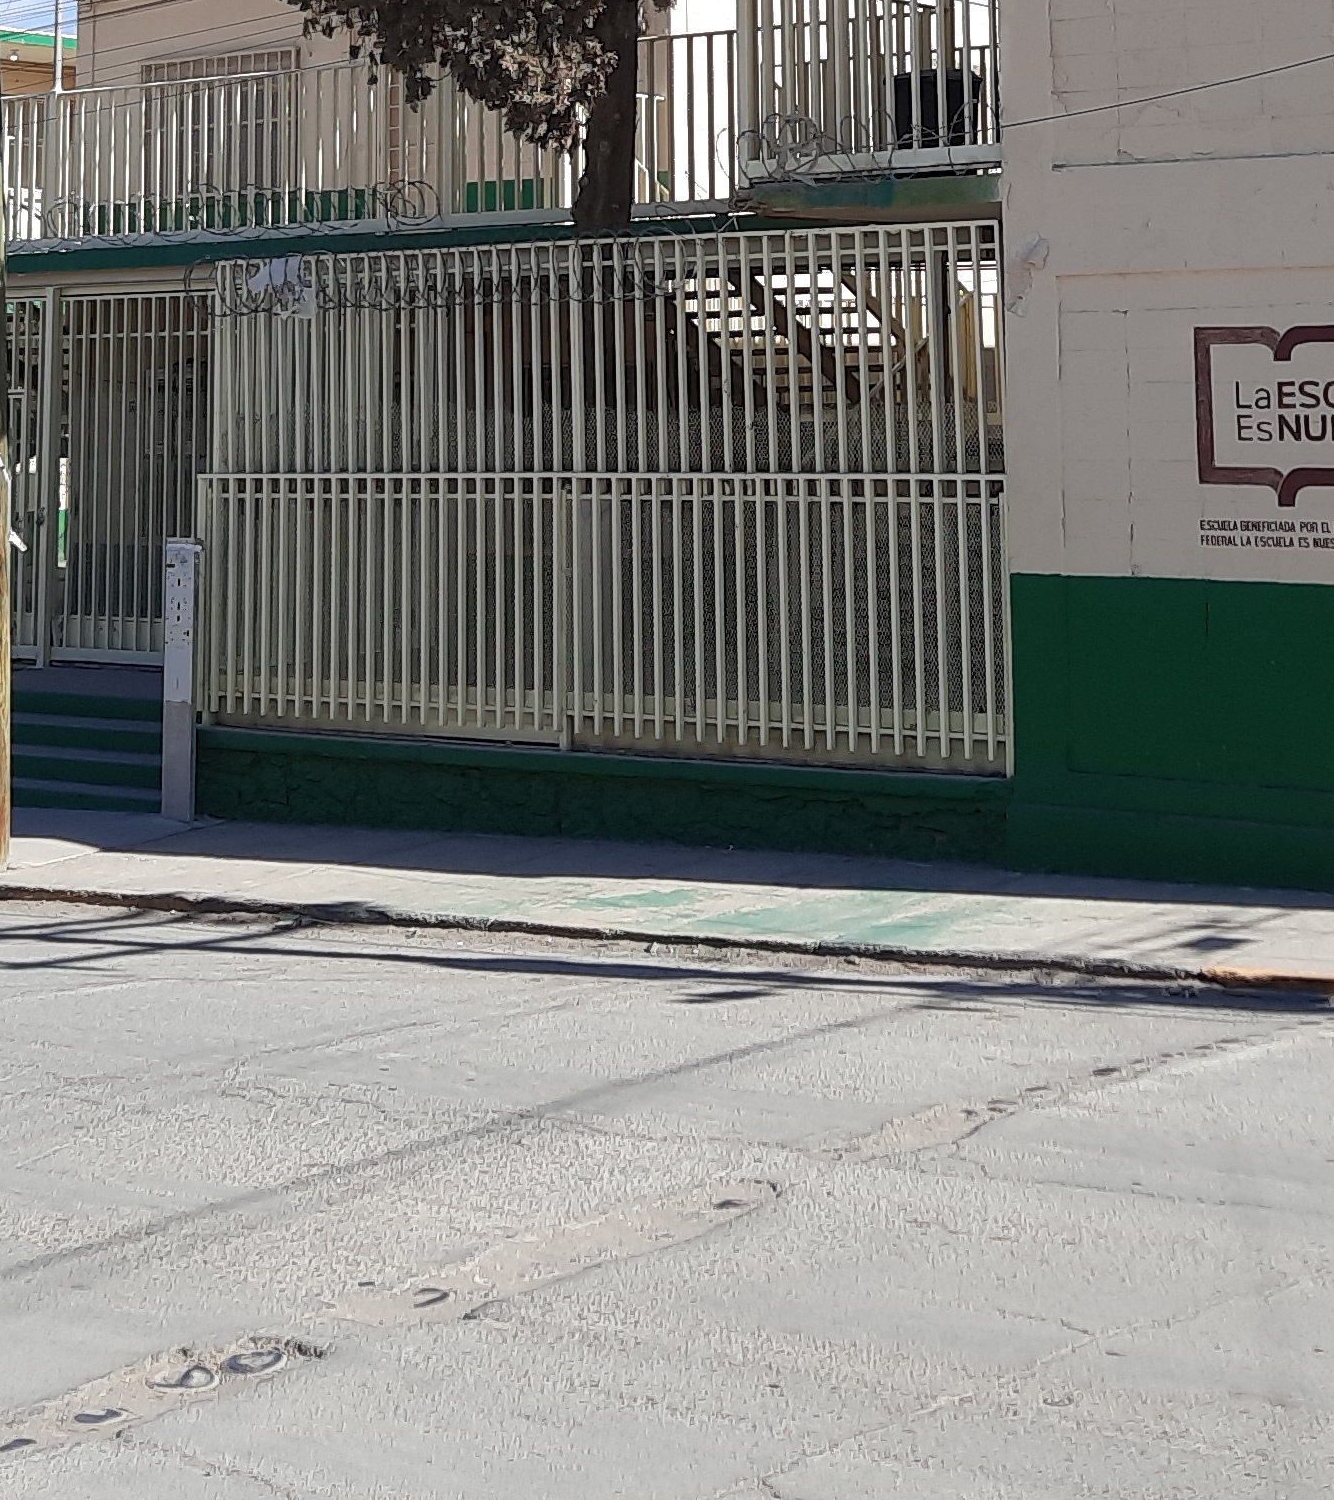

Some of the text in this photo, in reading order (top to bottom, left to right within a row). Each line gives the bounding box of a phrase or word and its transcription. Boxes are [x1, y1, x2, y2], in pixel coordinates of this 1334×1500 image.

[1200, 520, 1238, 532] ESCUELA
[1300, 521, 1318, 533] POR
[1200, 535, 1238, 547] FEDERAL
[1240, 535, 1252, 547] LA
[1255, 536, 1295, 548] ESCUELA
[1298, 537, 1310, 548] ES
